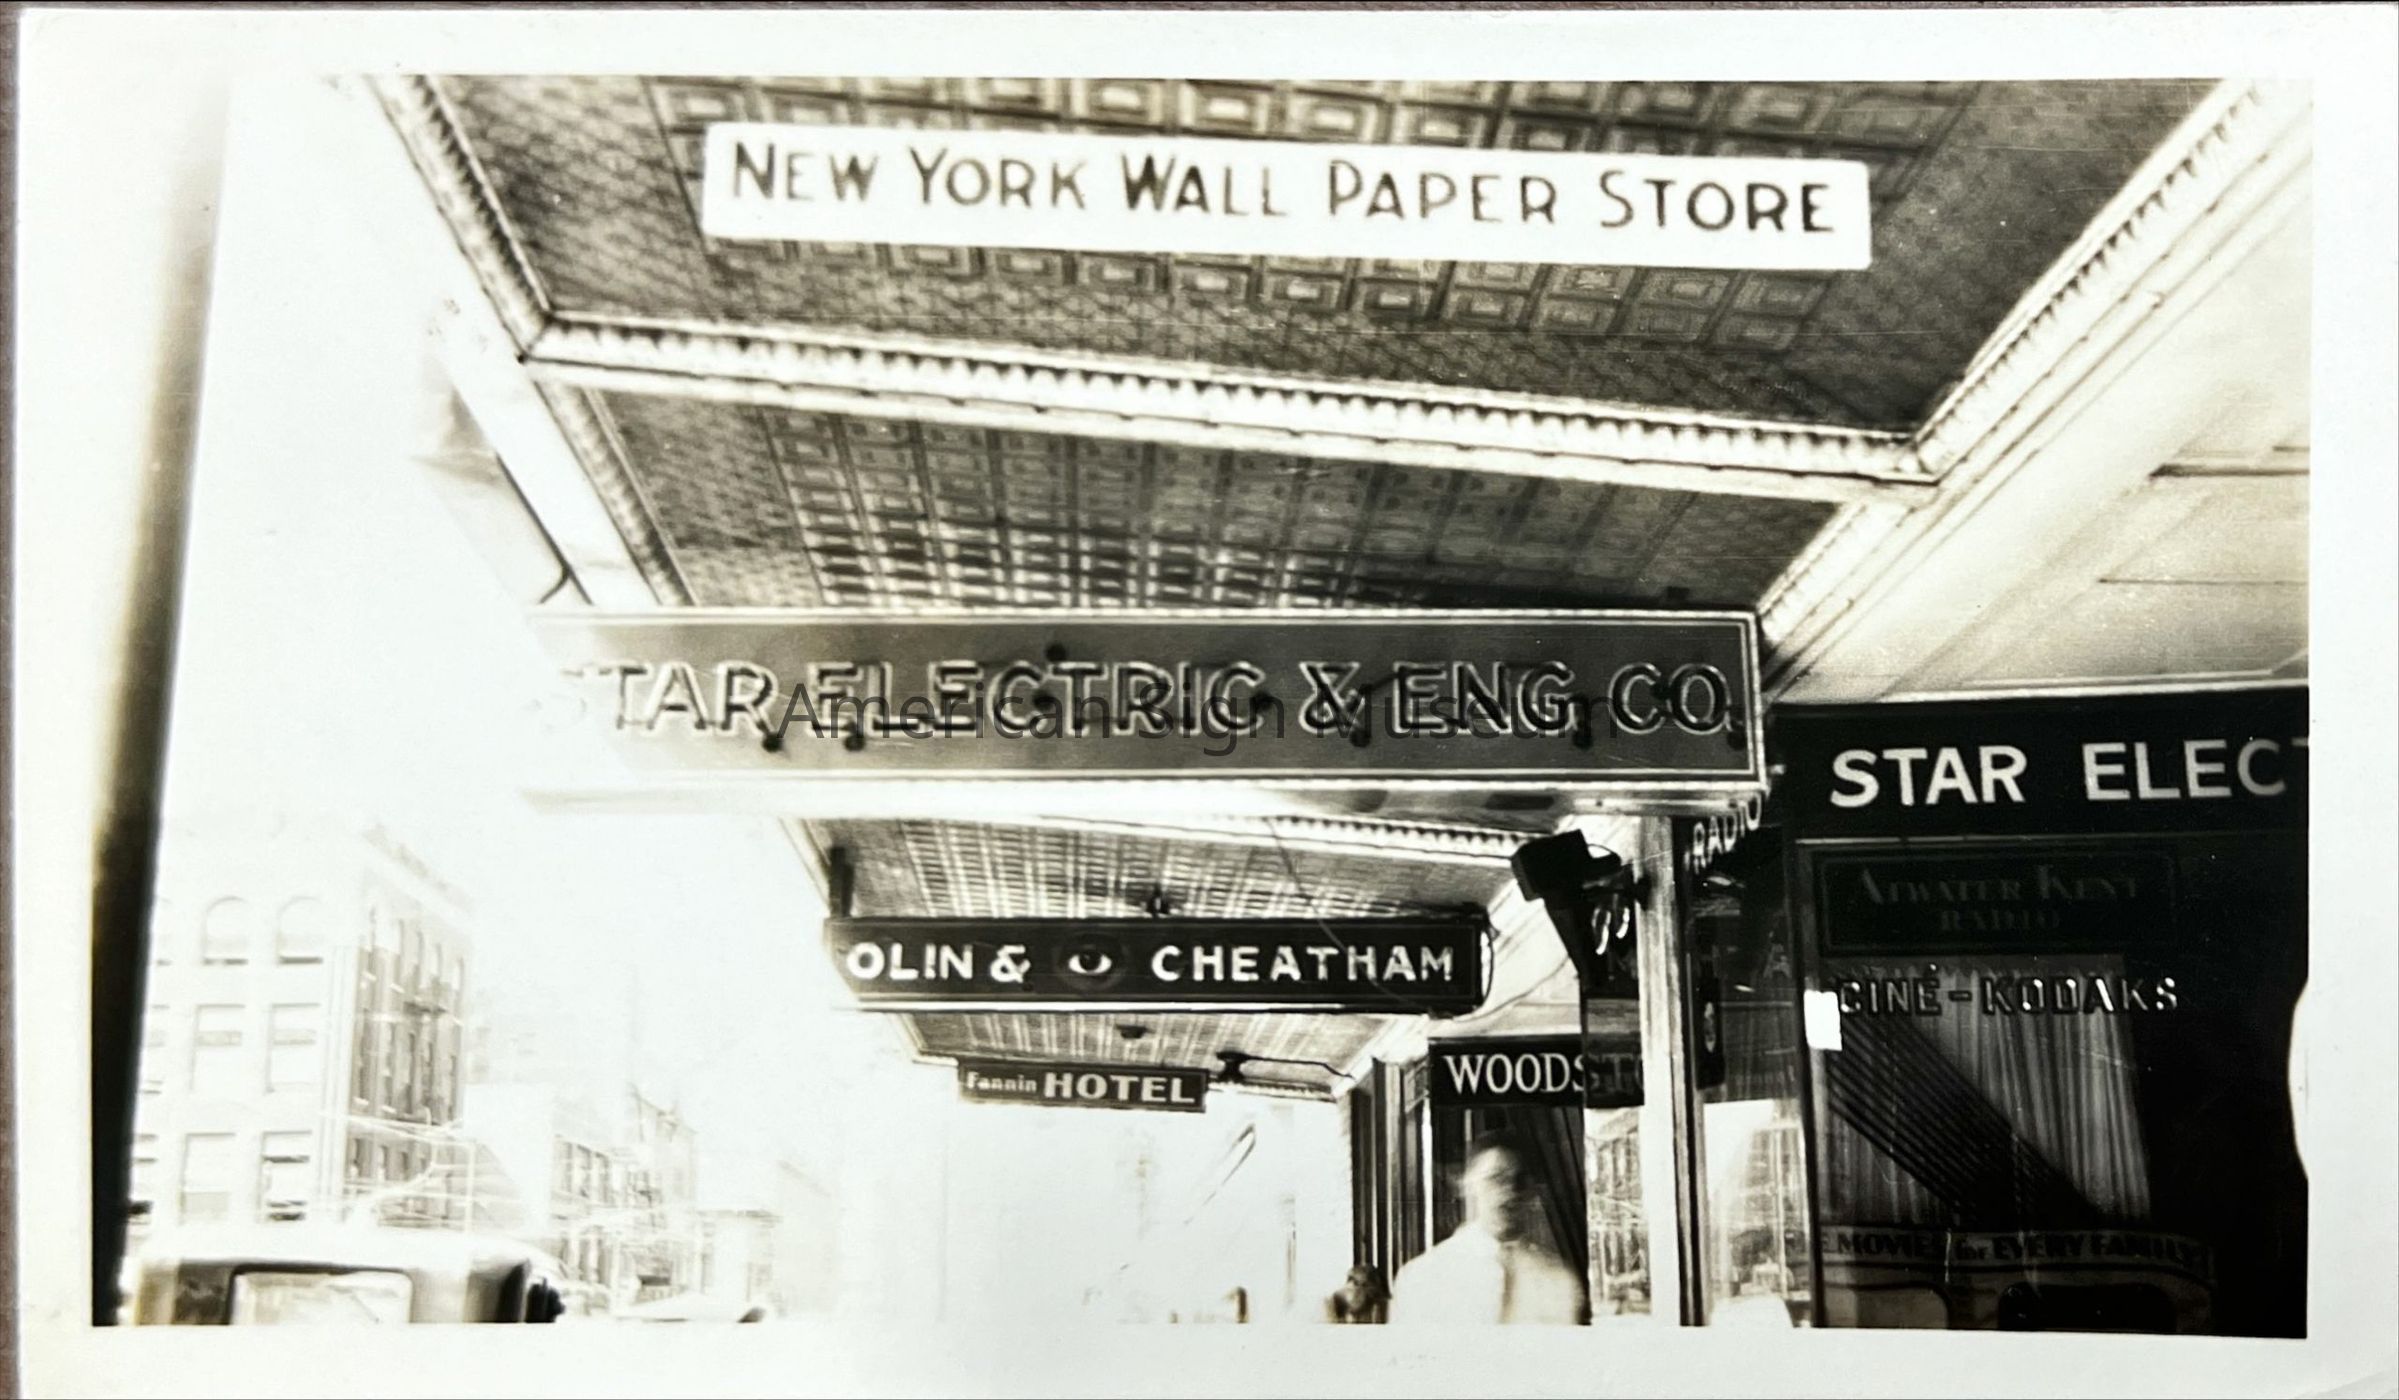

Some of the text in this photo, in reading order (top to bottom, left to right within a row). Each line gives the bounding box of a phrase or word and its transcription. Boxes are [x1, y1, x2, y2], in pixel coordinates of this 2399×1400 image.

[733, 140, 1835, 233] NEW YORK WALL PAPER STORE
[806, 659, 1264, 738] ELECTRIC
[1298, 660, 1365, 734] &
[1829, 743, 2028, 809] STAR
[846, 941, 1455, 984] OLIN & CHEATHAM
[966, 1070, 1196, 1104] Fannin HOTEL
